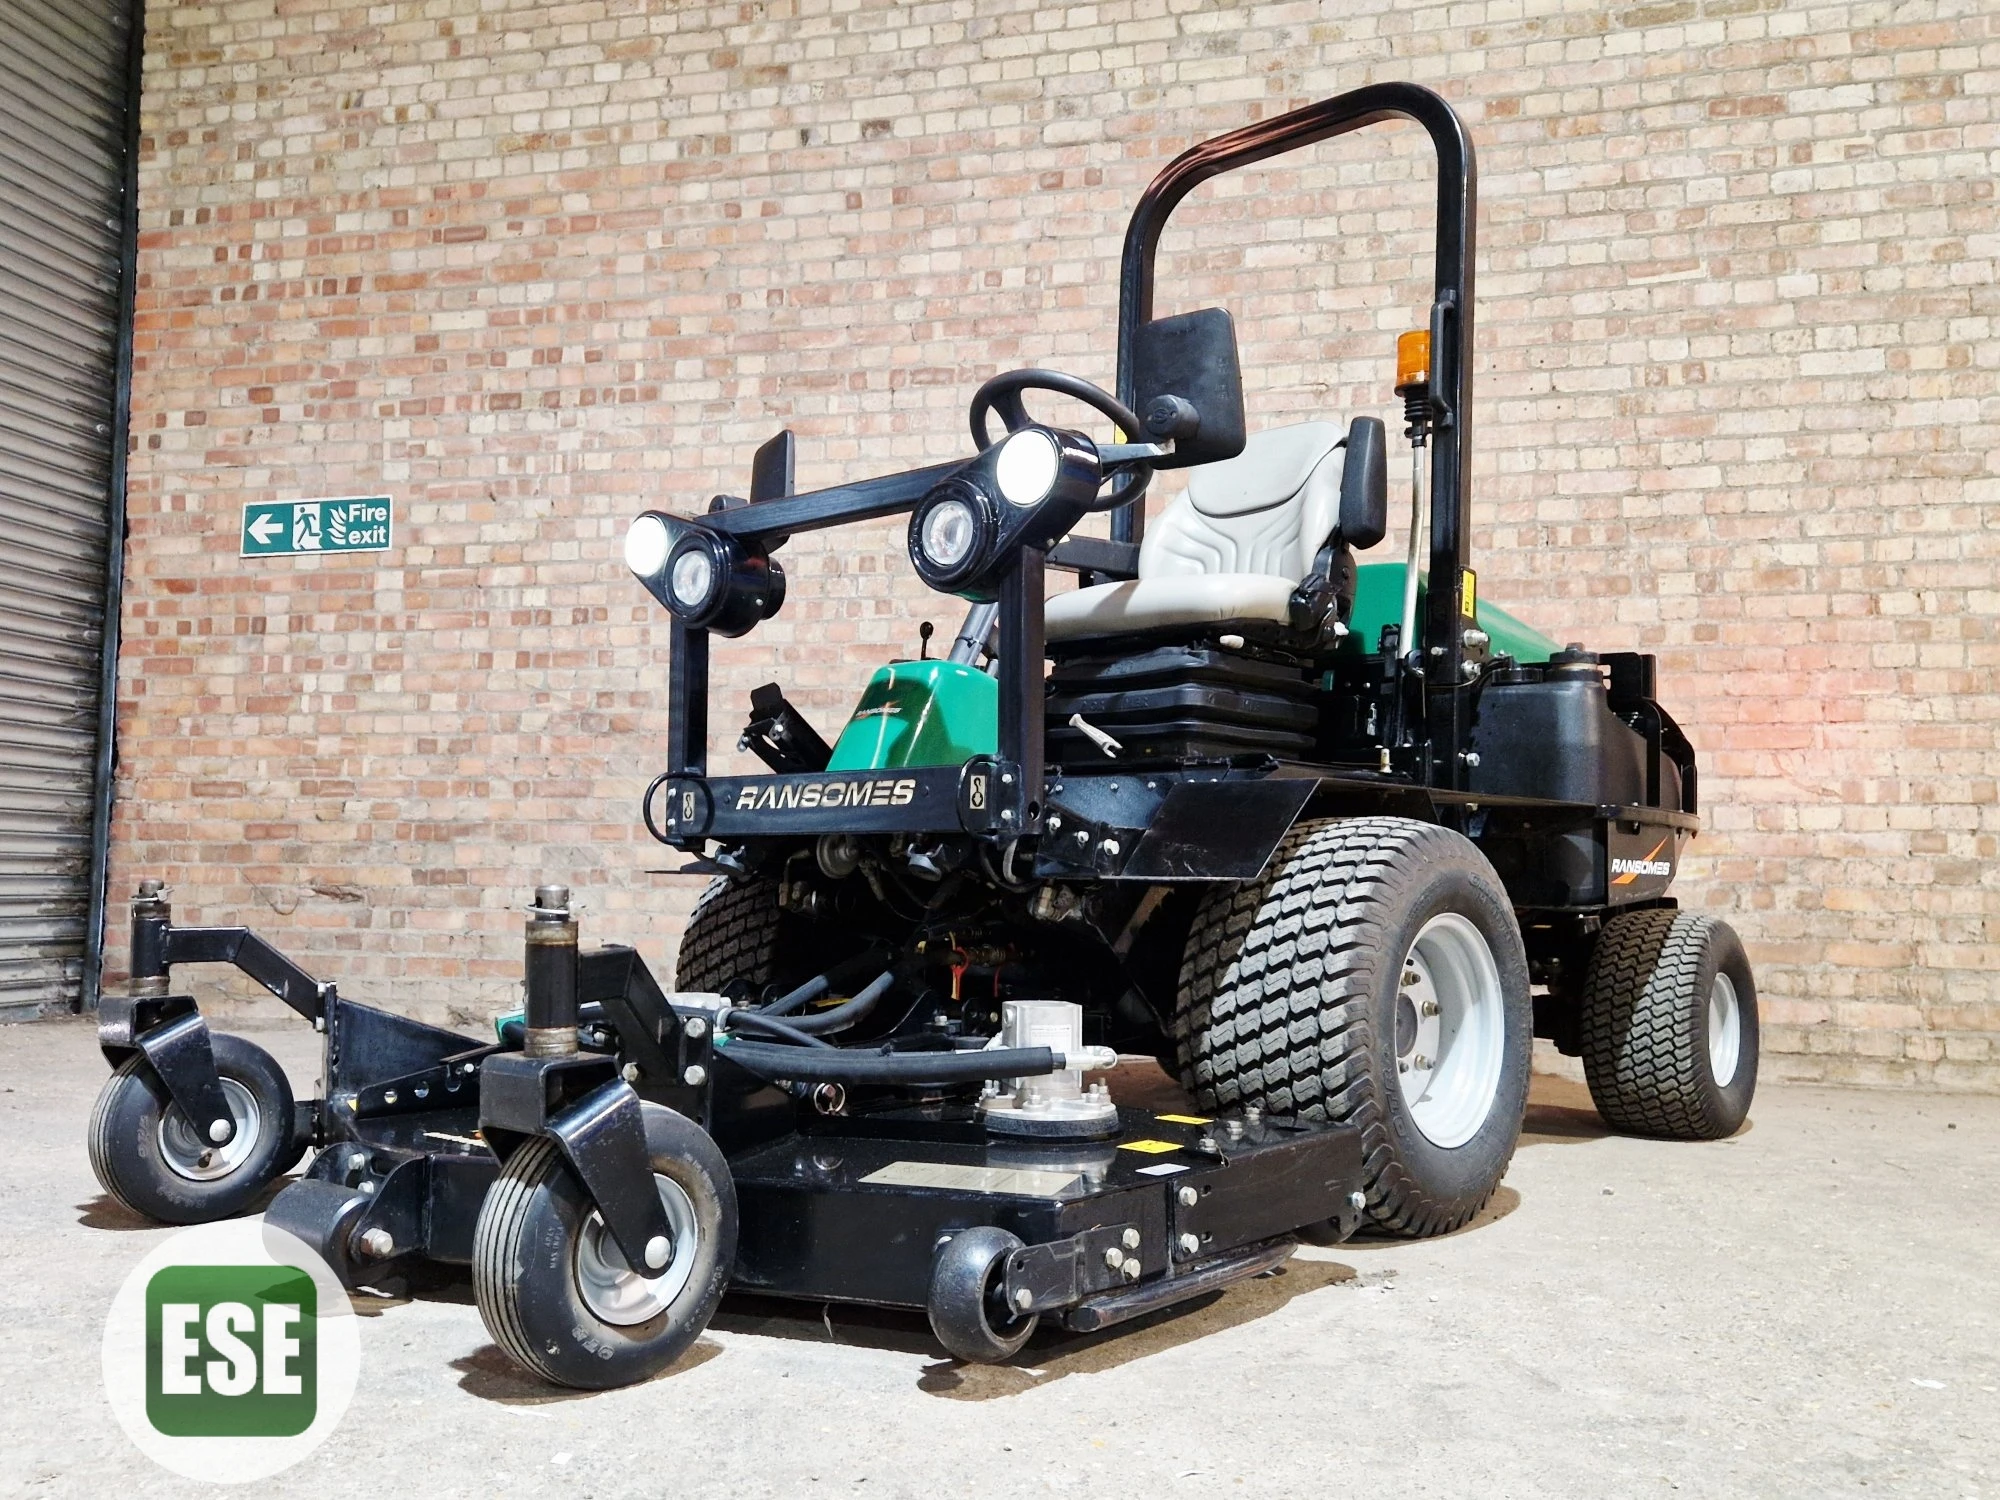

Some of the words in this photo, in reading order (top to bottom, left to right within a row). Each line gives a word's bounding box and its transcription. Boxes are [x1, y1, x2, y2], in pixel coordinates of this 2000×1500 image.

[348, 504, 387, 522] Fire
[348, 525, 386, 545] exit
[735, 779, 917, 810] RANSOMES
[1611, 858, 1670, 875] RANSOMES
